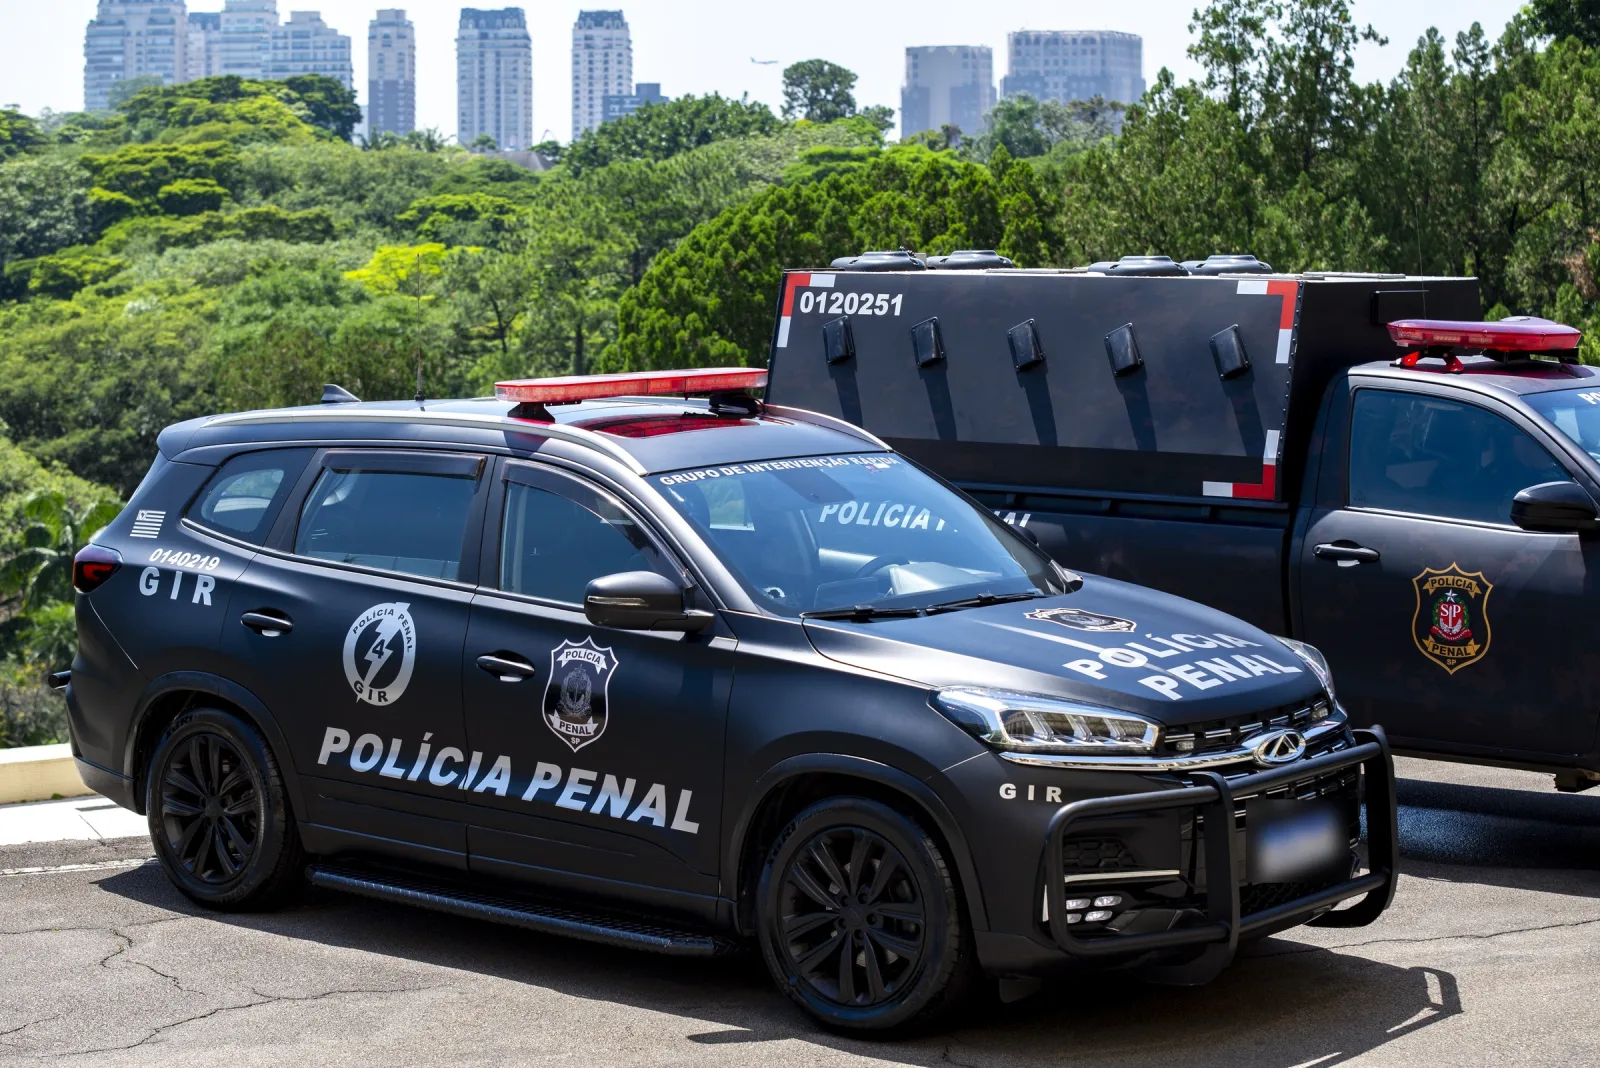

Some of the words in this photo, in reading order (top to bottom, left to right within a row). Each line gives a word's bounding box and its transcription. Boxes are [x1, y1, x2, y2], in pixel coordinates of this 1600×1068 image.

[799, 291, 903, 316] 0120251
[659, 469, 721, 486] GRUPO
[720, 466, 746, 477] DE
[743, 457, 849, 474] INTERVENÇÃO
[849, 456, 901, 466] RÁPIDA
[819, 500, 931, 530] POLÍCIA
[149, 548, 220, 571] 0140219
[1430, 576, 1474, 591] POLÍCIA
[352, 608, 395, 634] POLÍCIA
[397, 613, 413, 653] PENAL
[371, 640, 385, 659] 4
[565, 648, 601, 665] POLÍCIA
[1062, 631, 1263, 680] POLÍCIA
[1431, 644, 1471, 657] PENAL
[1446, 658, 1457, 666] SP
[1137, 653, 1302, 700] PENAL
[558, 721, 592, 735] PENAL
[570, 736, 581, 745] SP
[317, 726, 512, 797] POLÍCIA
[521, 760, 701, 835] PENAL
